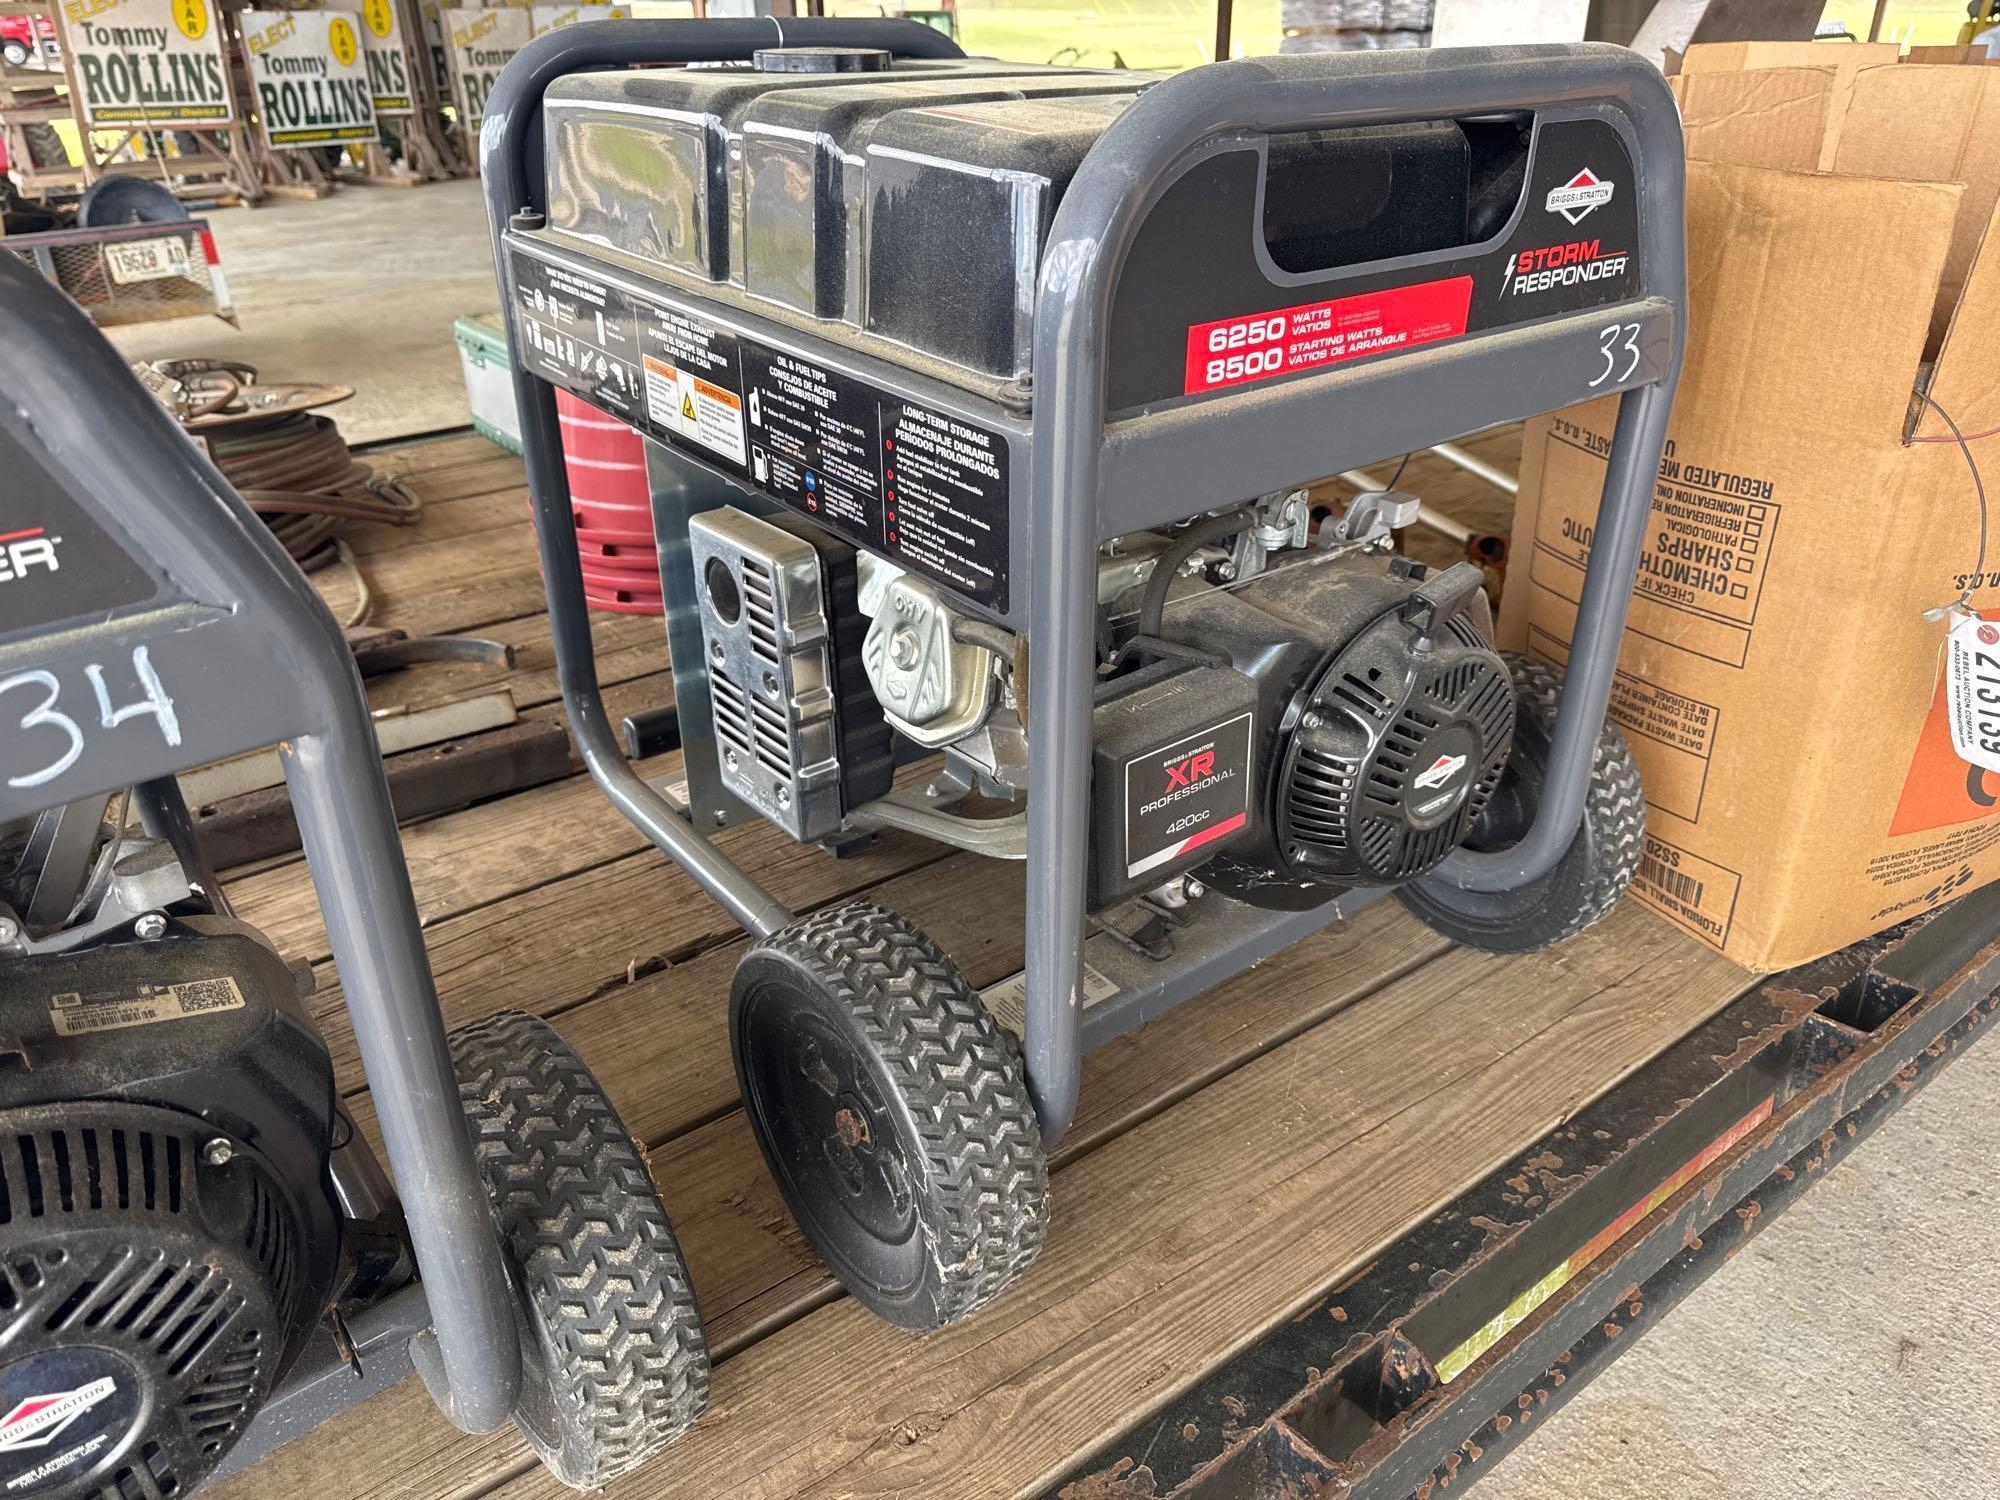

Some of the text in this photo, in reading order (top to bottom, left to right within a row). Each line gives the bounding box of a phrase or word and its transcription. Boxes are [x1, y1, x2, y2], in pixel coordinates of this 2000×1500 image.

[66, 0, 128, 24] ELEC
[80, 22, 168, 51] Tommy
[248, 16, 296, 54] ELECT
[455, 11, 498, 48] ELECT
[79, 53, 224, 104] ROLLINS
[260, 53, 328, 78] Tommy
[259, 79, 372, 127] ROLLINS
[1517, 240, 1600, 273] STORM
[1513, 259, 1627, 296] RESPONDER
[654, 308, 716, 339] POINT ENGINE EXHAUST
[1292, 320, 1332, 336] VATIOS
[1293, 308, 1331, 323] WATTS
[648, 328, 729, 368] APUNTE EL ESCAPE DEL MOTOR
[662, 321, 710, 347] AWAY FROM HOME
[1208, 317, 1285, 352] 6250
[1289, 326, 1383, 354] STARTING WATTS
[663, 343, 712, 370] LEJOS DE LA CASA
[1288, 332, 1408, 366] VATIOS DE ARRANQUE
[1588, 322, 1642, 388] 33
[777, 355, 827, 383] OIL & FUEL TIPS
[1206, 348, 1283, 383] 8500
[769, 365, 837, 402] CONSEJOS DE ACEITE
[778, 380, 829, 409] Y COMBUSTIBLE
[903, 404, 990, 448] LONG-TERM STORAGE
[895, 428, 1000, 480] PERÍODOS PROLONGADOS
[899, 418, 995, 466] ALMACENAJE DURANTE
[1683, 463, 1775, 500] REGULATED
[1663, 503, 1742, 532] REFRIGERATION
[1675, 489, 1745, 517] INCINERATION
[1665, 518, 1738, 547] PATHOLOGICAL
[1657, 532, 1734, 571] SHARPS
[1641, 576, 1696, 604] CHECK IF
[1632, 689, 1681, 716] CONTAINER
[1653, 689, 1710, 717] IN STORAGE
[1962, 650, 1974, 745] REBEL AUCTION COMPANY
[0, 645, 181, 788] 34
[1647, 709, 1678, 729] WASTE
[1680, 722, 1706, 739] DATE
[1682, 710, 1708, 726] DATE
[1645, 725, 1676, 741] WASTE
[1678, 737, 1704, 751] DATE
[1165, 750, 1215, 794] XR
[1140, 768, 1236, 816] PROFESSIONAL
[1166, 809, 1210, 835] 420cc
[1646, 839, 1680, 868] SS20
[1886, 859, 1915, 870] FLORIDA
[1891, 848, 1920, 859] FLORIDA
[1892, 863, 1920, 875] FLORIDA
[1903, 868, 1931, 880] FLORIDA
[1648, 884, 1723, 937] FLORIDA SMALL
